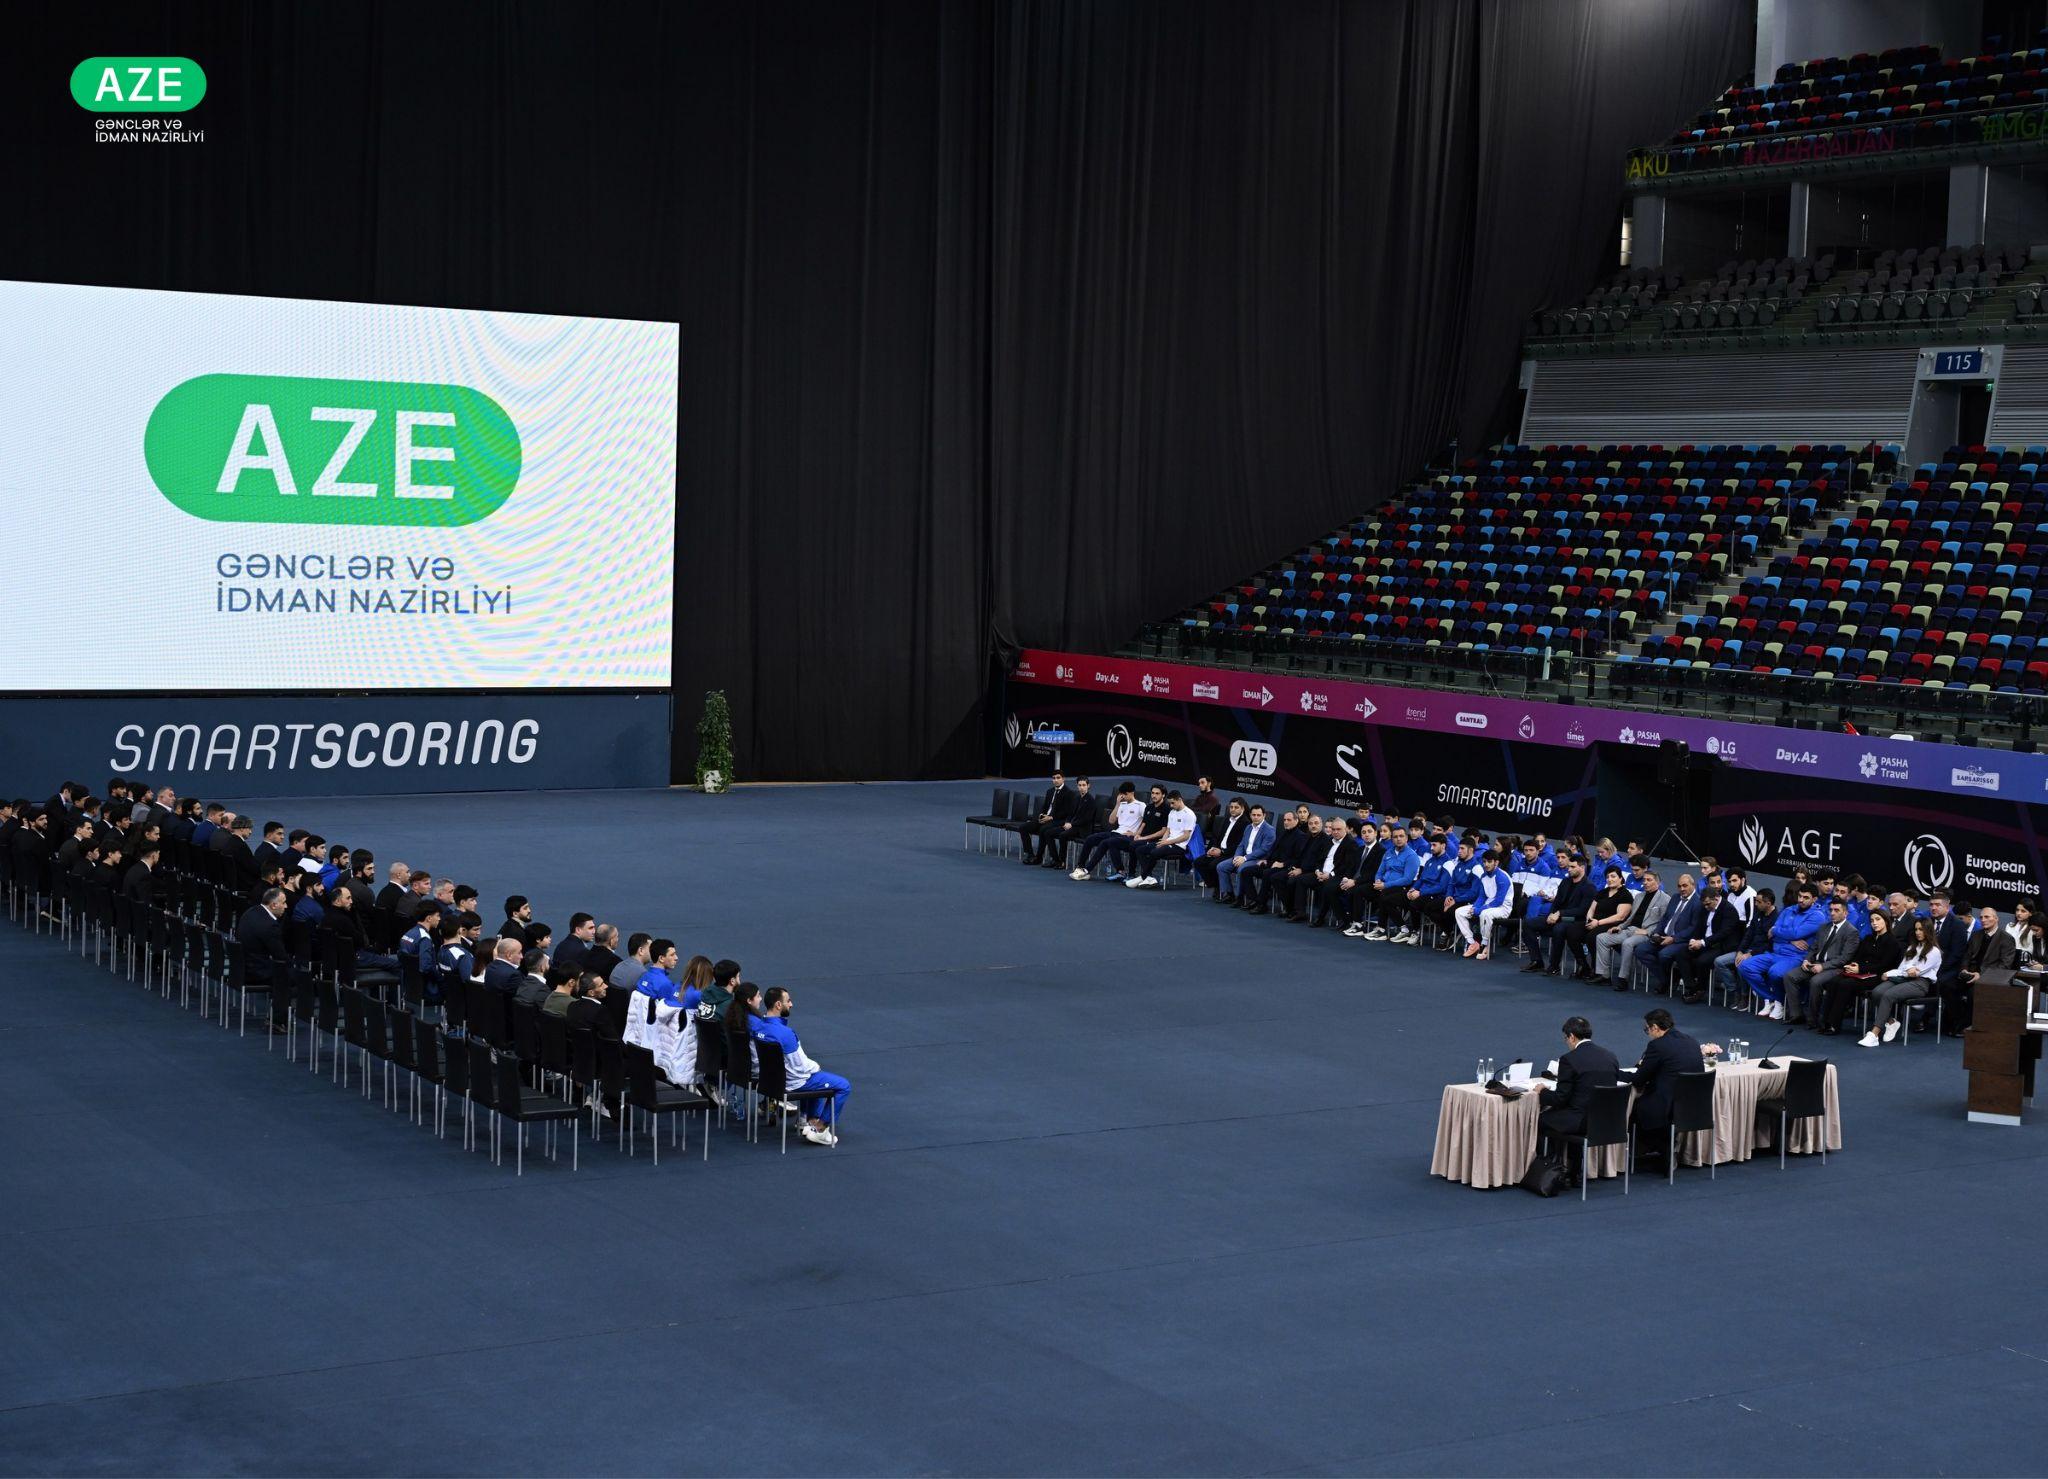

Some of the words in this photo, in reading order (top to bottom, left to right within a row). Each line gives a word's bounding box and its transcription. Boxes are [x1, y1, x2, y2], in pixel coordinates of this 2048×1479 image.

[1625, 153, 1669, 178] AKU
[1947, 354, 1972, 370] 115
[216, 403, 456, 500] AZE
[216, 553, 395, 580] GƏNCLƏR
[407, 556, 455, 581] VƏ
[217, 581, 336, 613] İDMAN
[350, 584, 512, 614] NAZİRLİYİ
[1064, 667, 1073, 678] LG
[1095, 672, 1119, 683] Day.Az
[1154, 684, 1170, 694] Travel
[1313, 703, 1327, 712] Bank
[1567, 731, 1585, 742] times
[1637, 730, 1661, 741] PASHA
[110, 719, 540, 772] SMARTSCORING
[1138, 737, 1170, 751] European
[1721, 740, 1736, 755] LG
[1137, 750, 1177, 766] Gymnastics
[1237, 746, 1268, 770] AZE
[1776, 748, 1818, 764] Day.Az
[1880, 756, 1909, 768] PASHA
[1880, 767, 1909, 780] Travel
[1334, 778, 1364, 796] MGA
[1437, 783, 1553, 818] SMARTSCORING
[1777, 826, 1843, 861] AGF
[1966, 853, 2026, 875] European
[1965, 872, 2041, 895] Gymnastics
